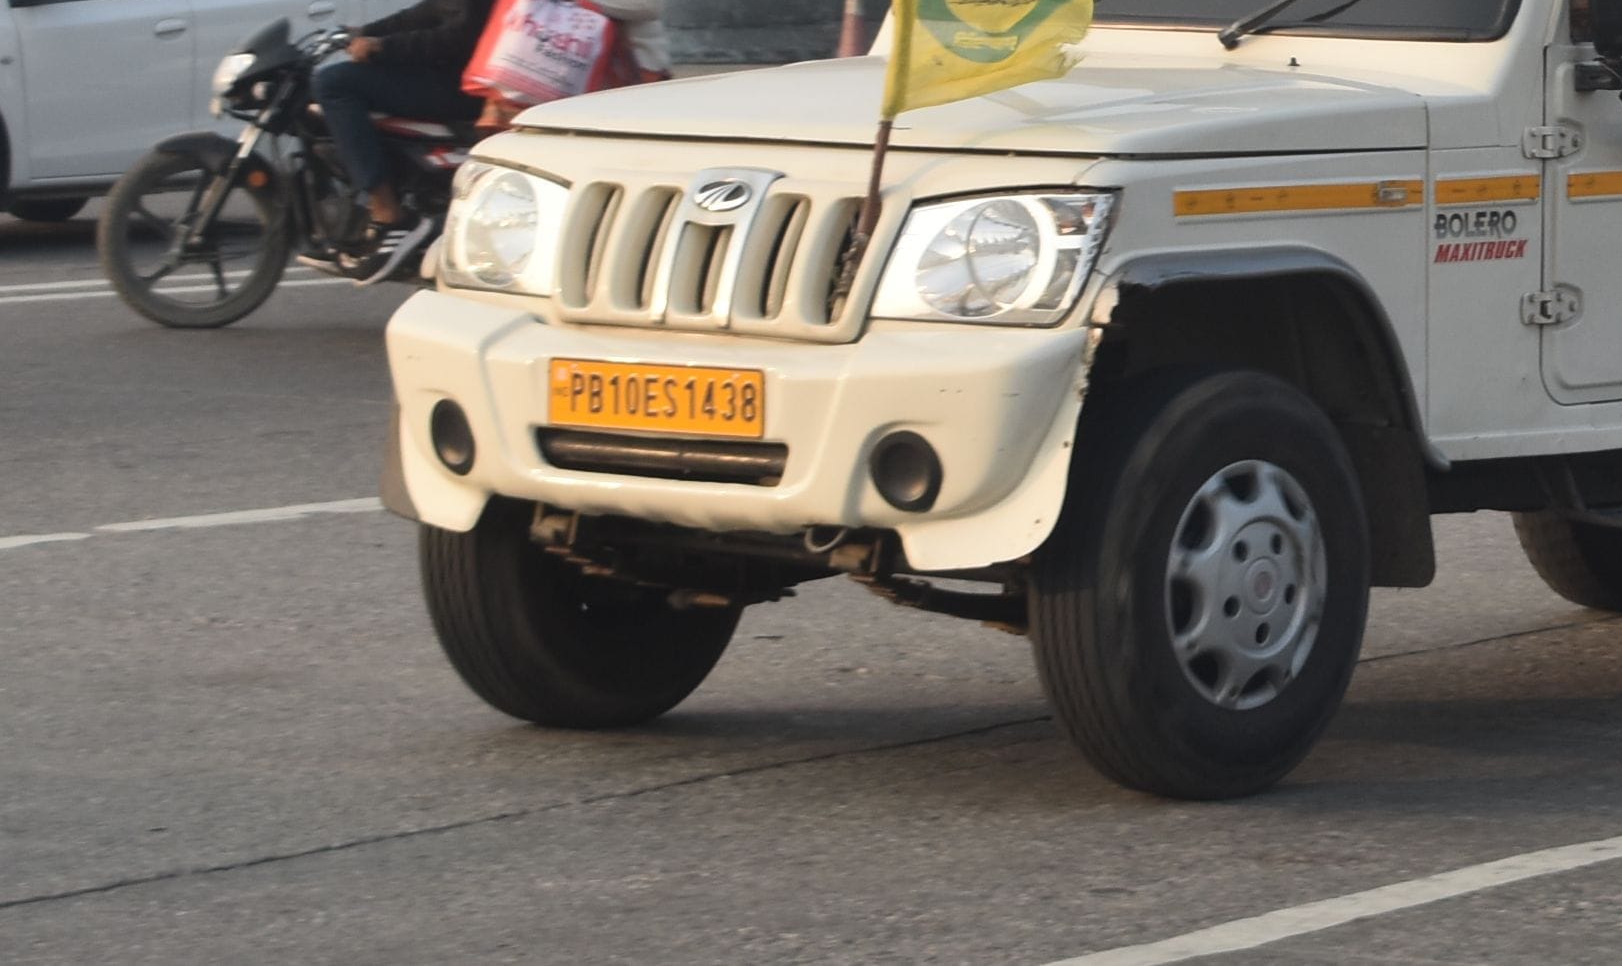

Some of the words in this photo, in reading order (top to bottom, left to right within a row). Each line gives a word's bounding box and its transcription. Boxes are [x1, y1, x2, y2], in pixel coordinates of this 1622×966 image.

[1434, 210, 1517, 239] BOLERO
[1434, 239, 1528, 264] MAXITRUCK
[570, 371, 757, 422] PB10ES1438
